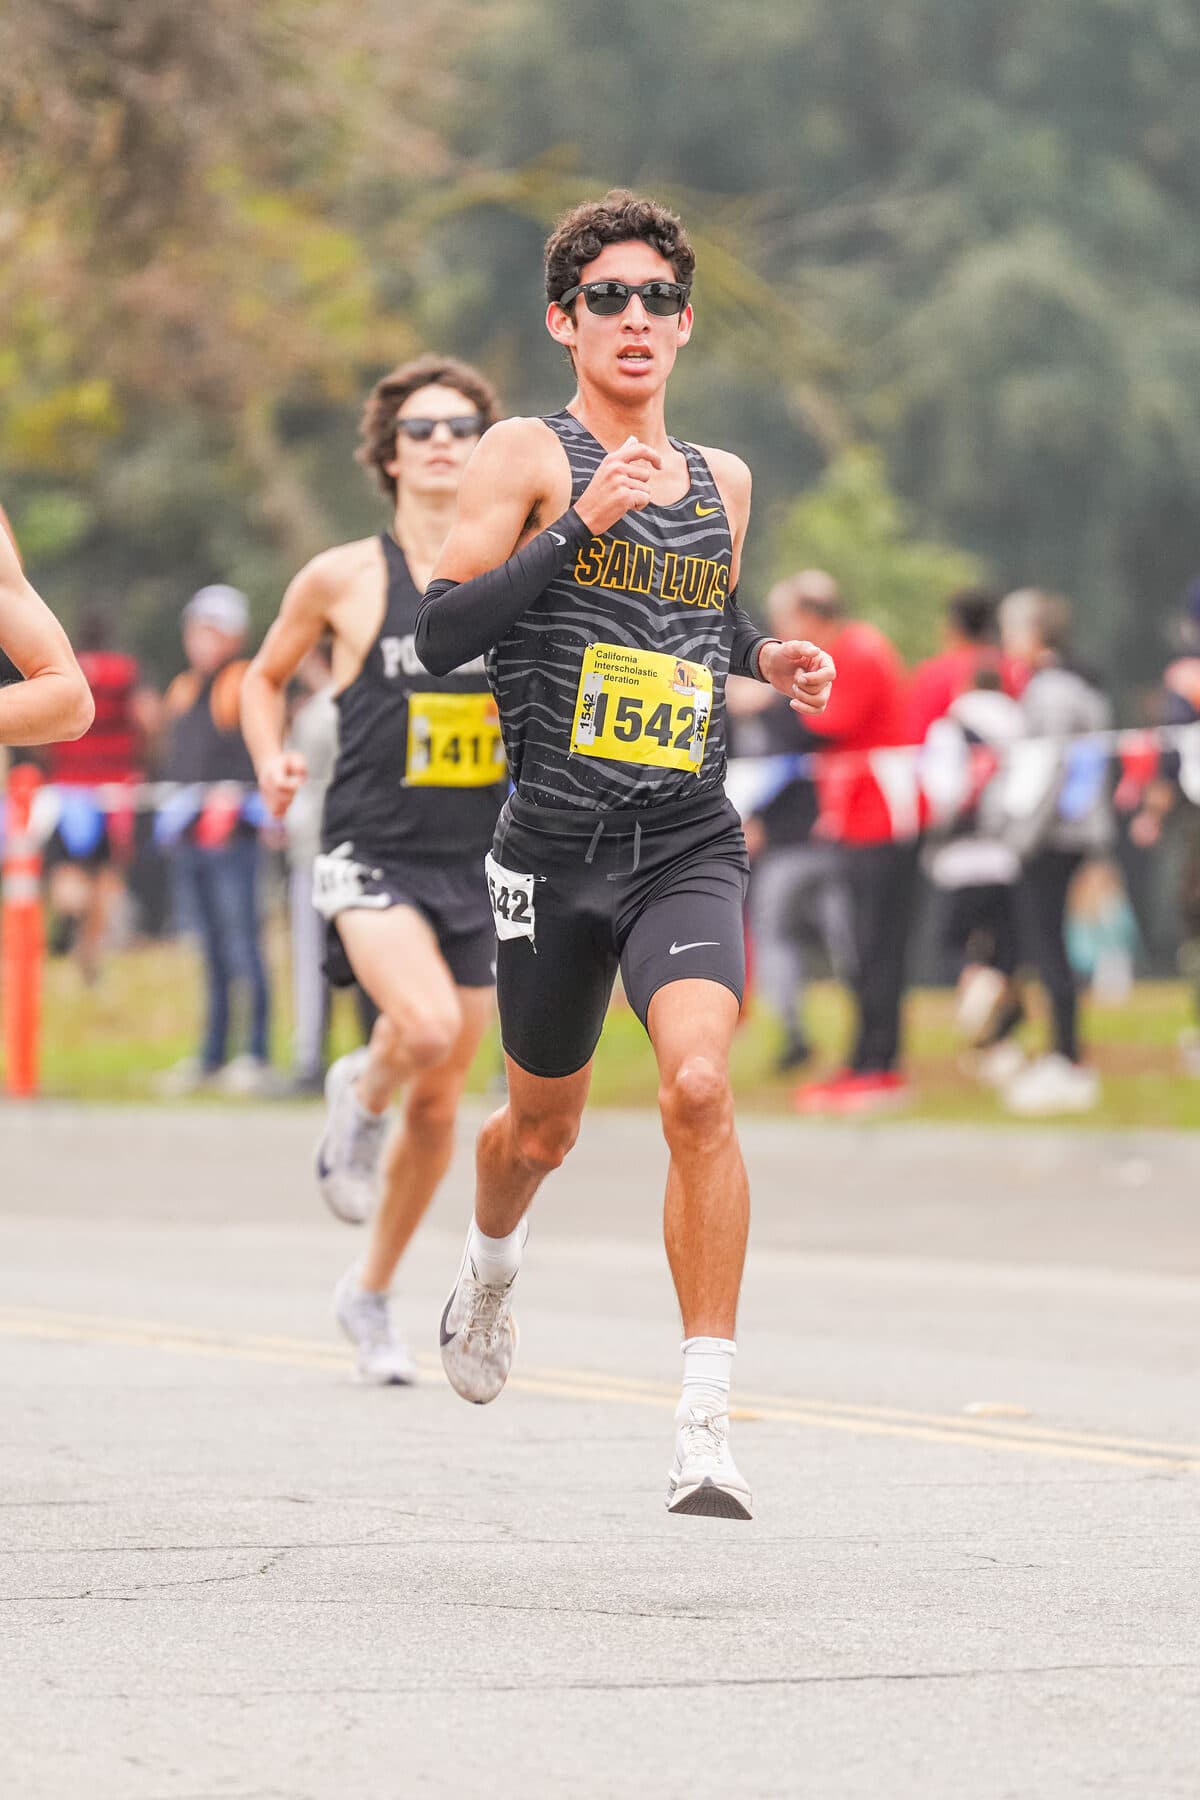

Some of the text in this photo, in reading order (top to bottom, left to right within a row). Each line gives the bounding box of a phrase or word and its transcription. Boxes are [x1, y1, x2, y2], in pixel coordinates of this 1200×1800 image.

[574, 538, 729, 611] SAN LUIS
[594, 661, 658, 678] Interscholastic
[596, 650, 638, 664] California
[593, 672, 640, 686] deration
[580, 693, 595, 729] 1542
[594, 693, 697, 750] 1542
